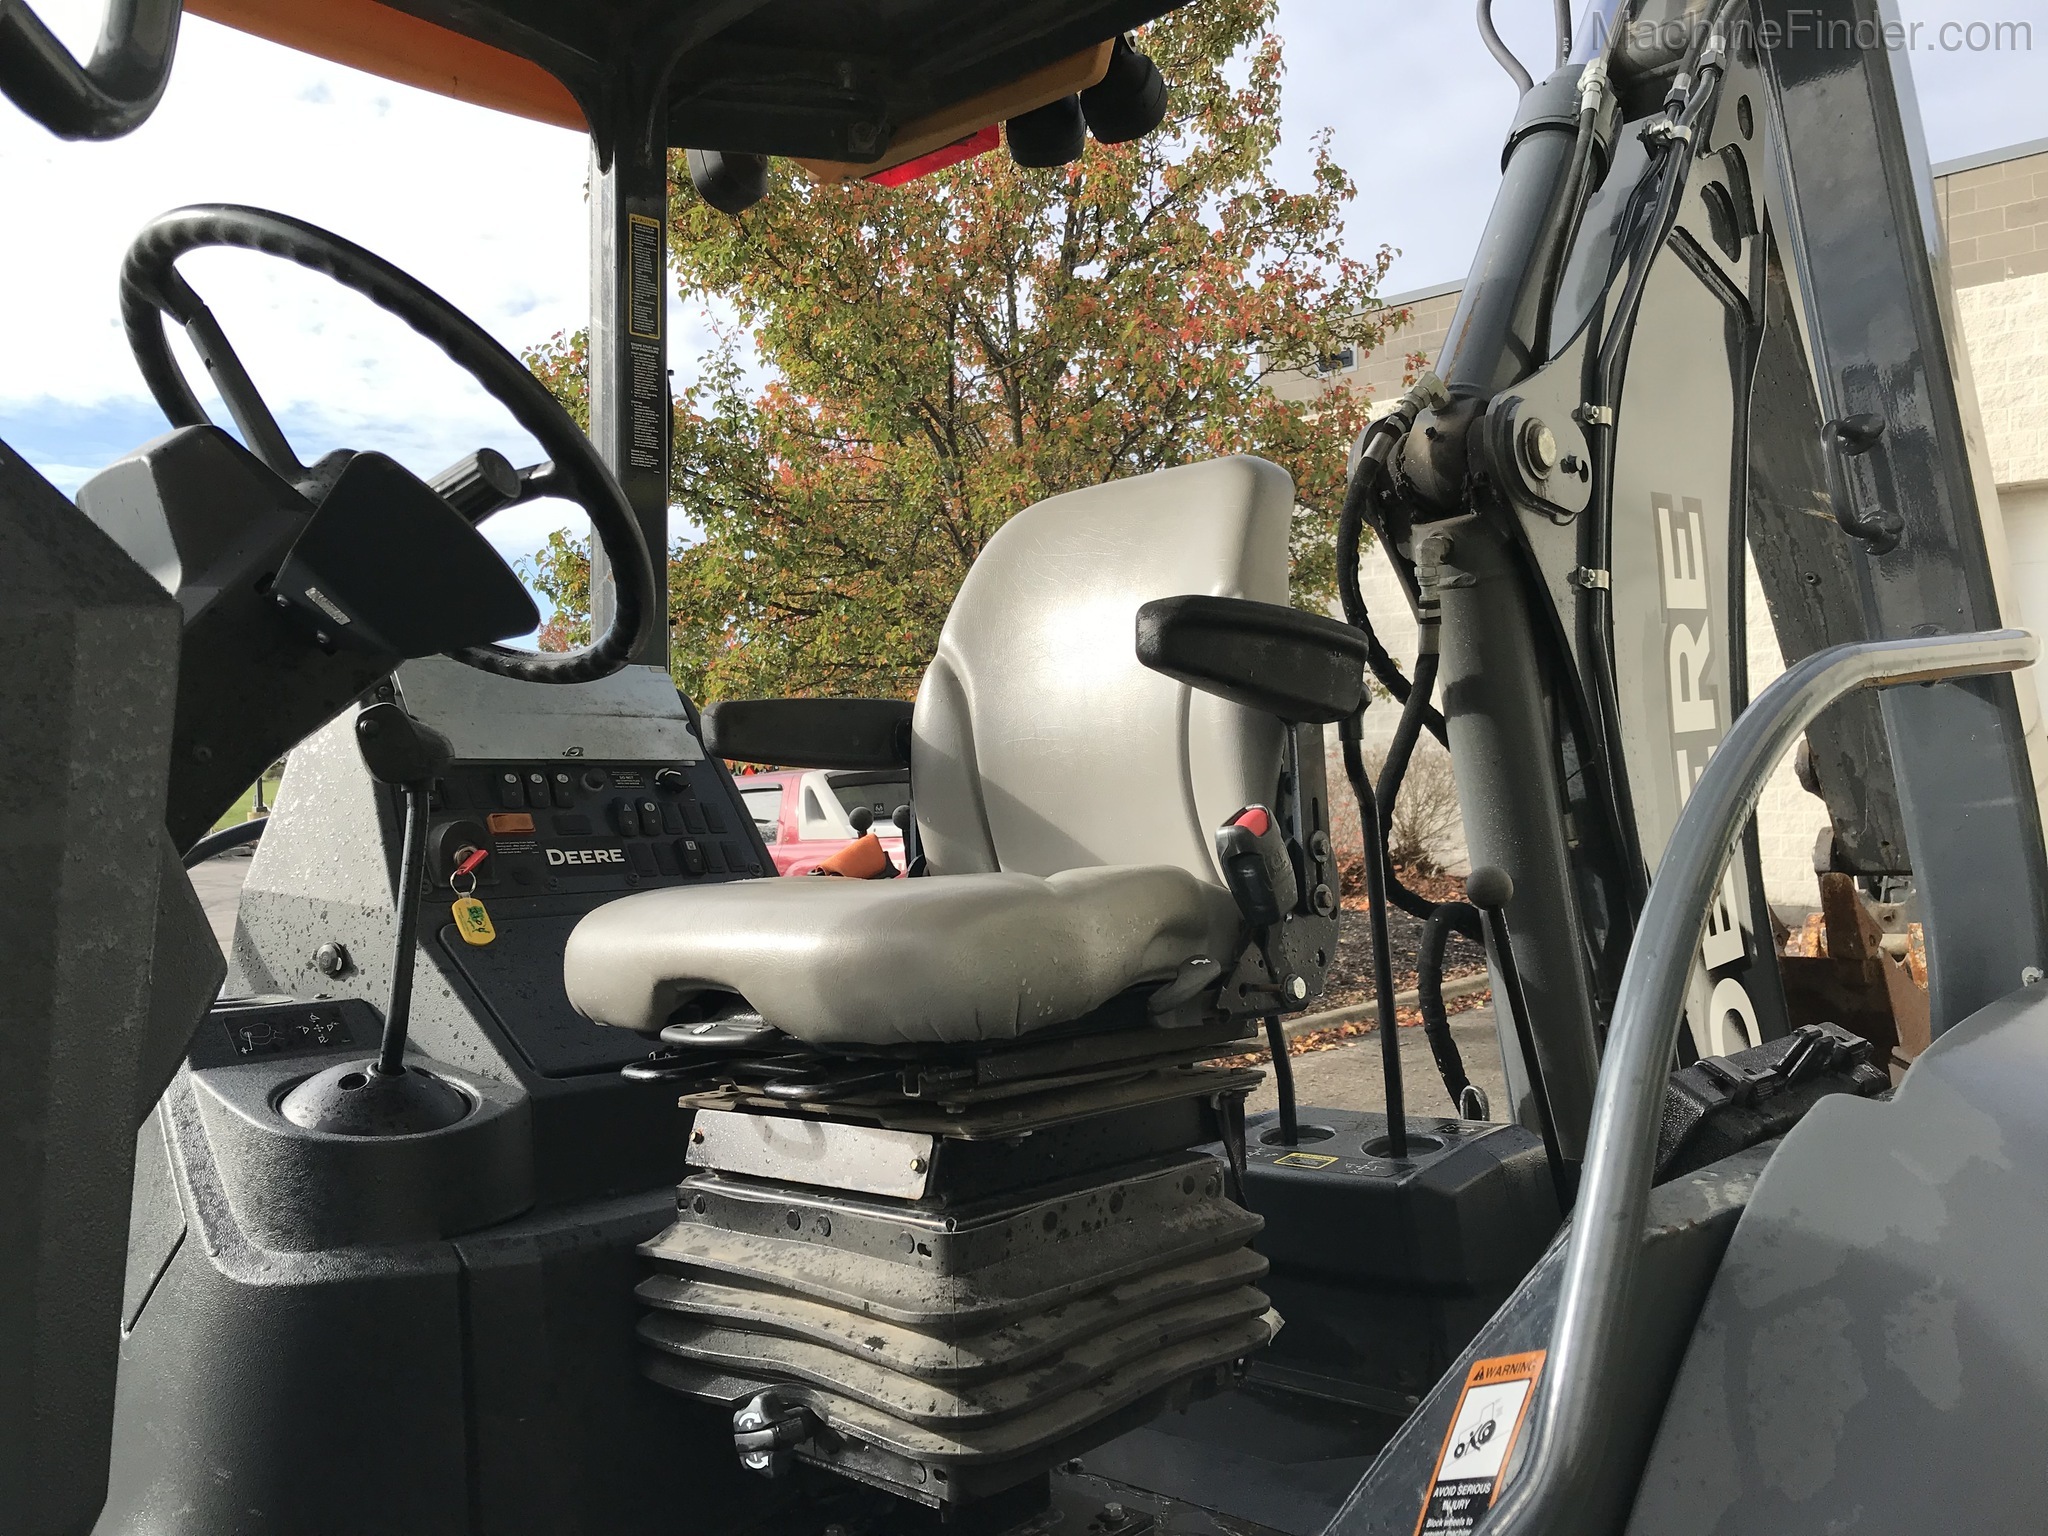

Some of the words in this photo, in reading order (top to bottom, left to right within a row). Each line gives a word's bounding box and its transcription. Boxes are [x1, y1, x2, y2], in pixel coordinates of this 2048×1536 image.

[545, 848, 626, 866] DEERE
[1433, 1485, 1457, 1498] AVOID
[1456, 1482, 1492, 1496] SERIOUS
[1442, 1499, 1471, 1511] INJURY
[1426, 1518, 1443, 1528] Block
[1443, 1517, 1465, 1527] wheels
[1466, 1517, 1473, 1526] to
